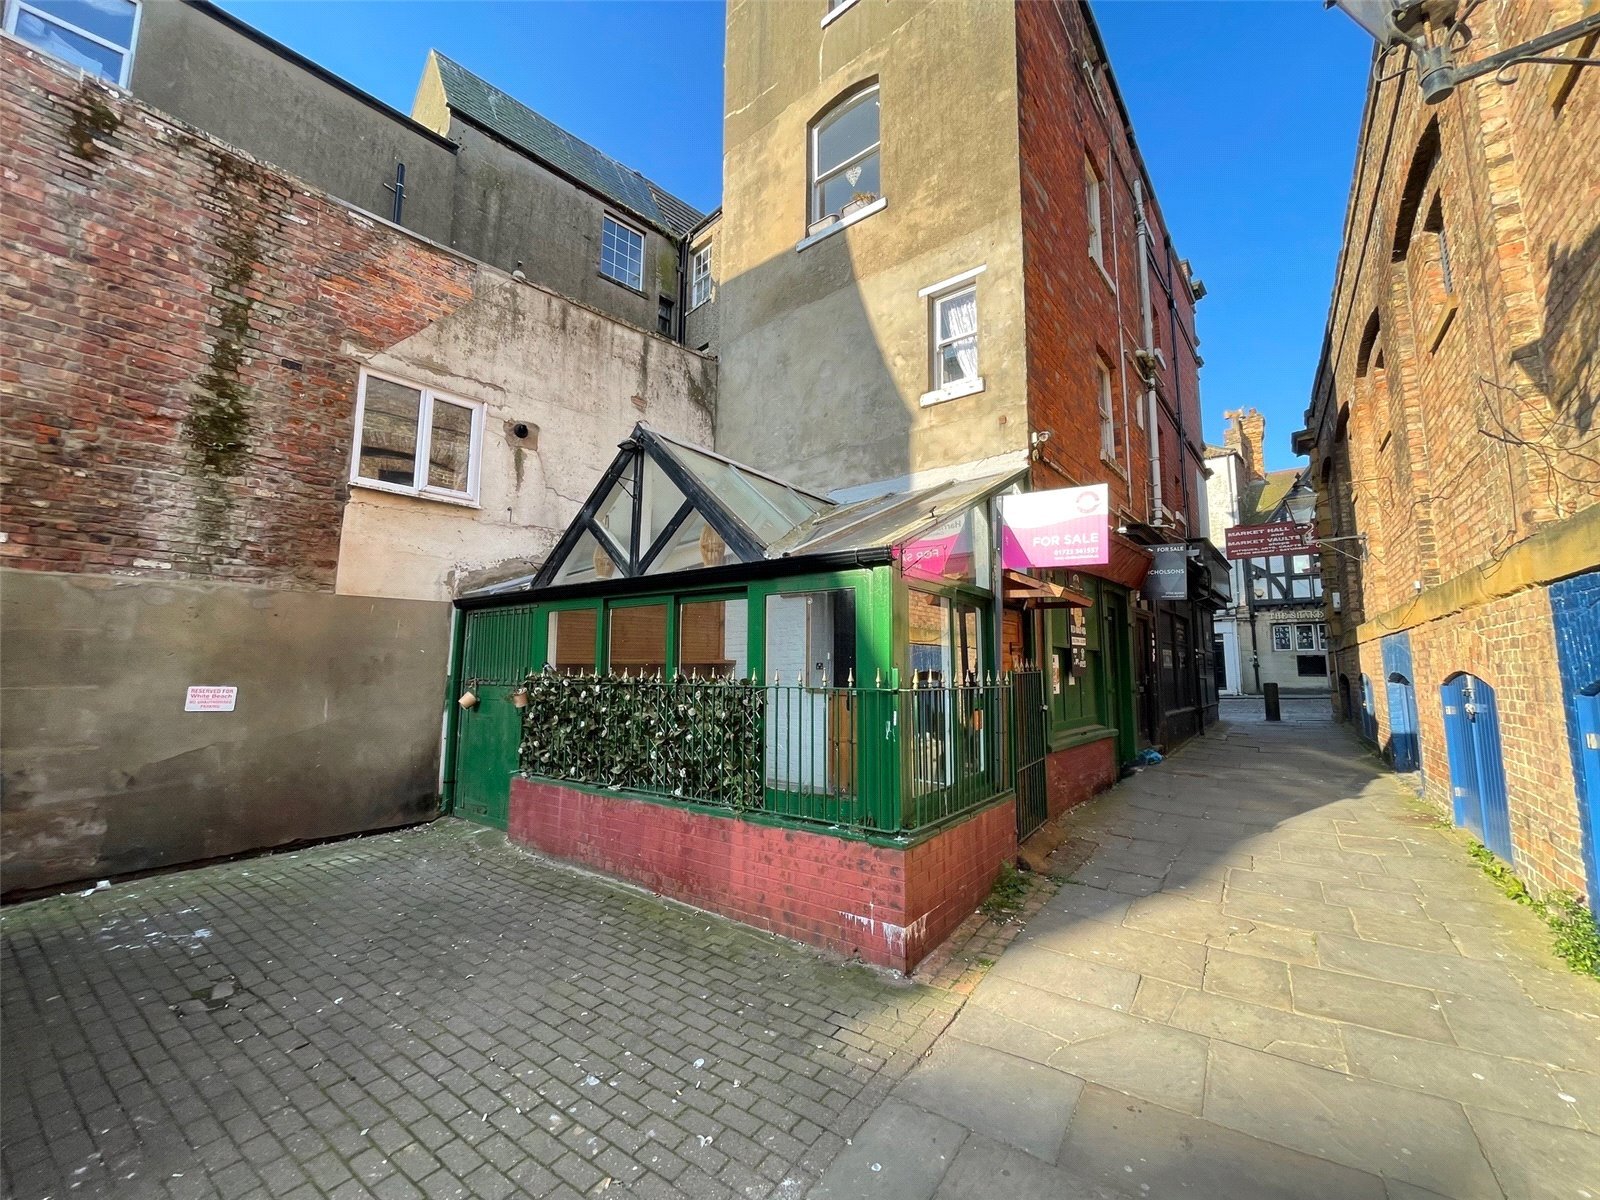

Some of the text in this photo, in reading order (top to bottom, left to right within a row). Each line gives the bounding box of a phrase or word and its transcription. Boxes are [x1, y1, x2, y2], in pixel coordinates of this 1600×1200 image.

[1228, 529, 1264, 537] MARKET
[1032, 532, 1099, 547] FOR SALE
[1228, 535, 1301, 547] MARKET VAULTS
[1148, 568, 1184, 576] ICHOLSONS
[1290, 610, 1325, 619] SHAKE
